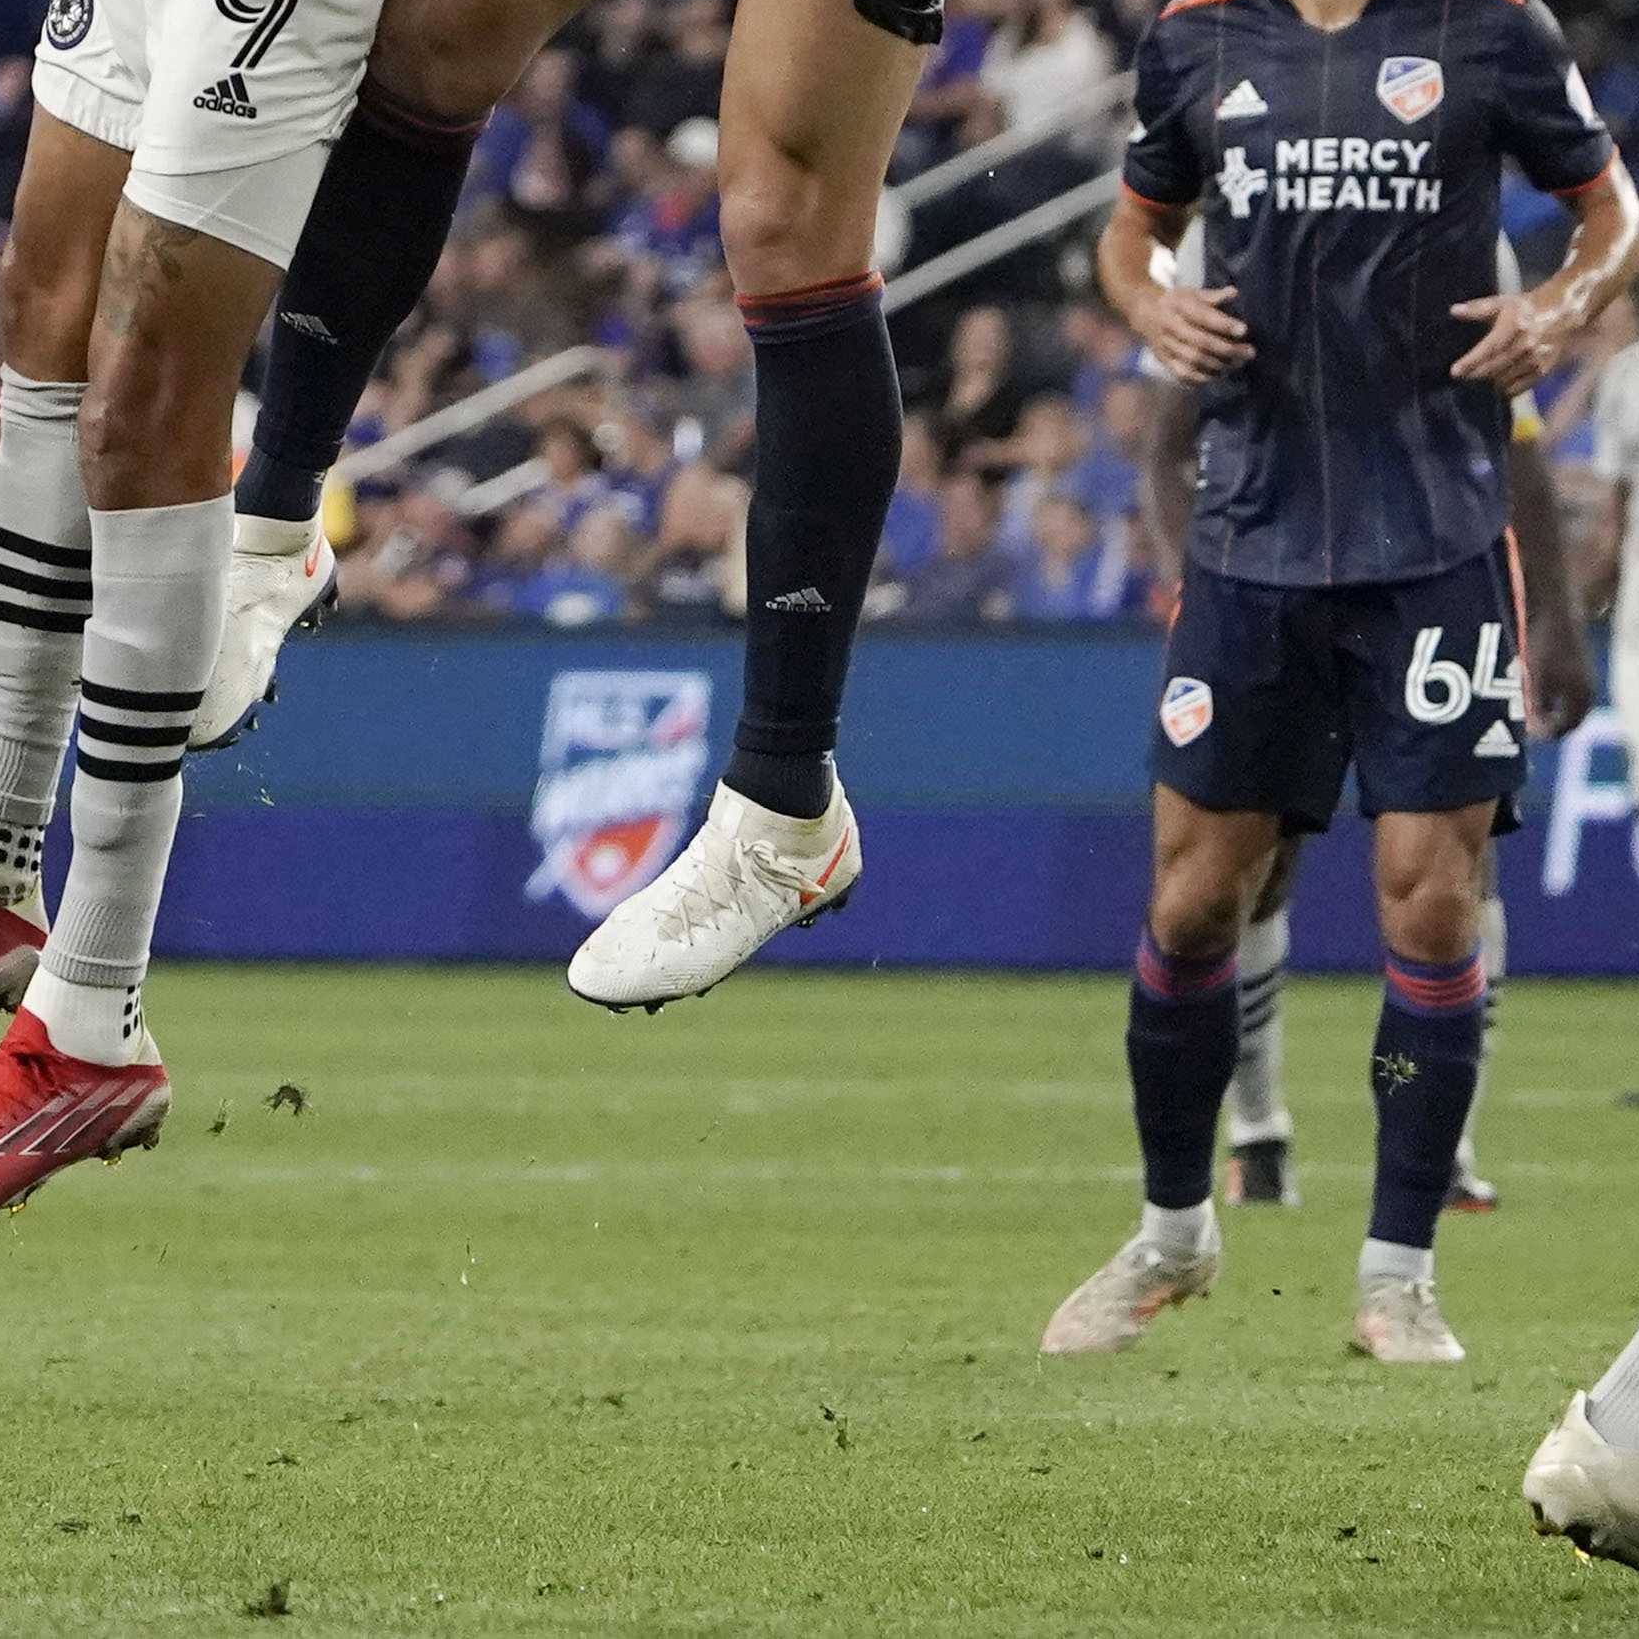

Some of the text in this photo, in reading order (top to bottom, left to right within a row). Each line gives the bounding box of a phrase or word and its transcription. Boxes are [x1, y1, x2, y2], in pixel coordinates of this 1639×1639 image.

[193, 96, 257, 120] adidas
[1275, 137, 1432, 174] MERCY
[1275, 175, 1442, 213] HEALTH
[1404, 621, 1529, 725] 64
